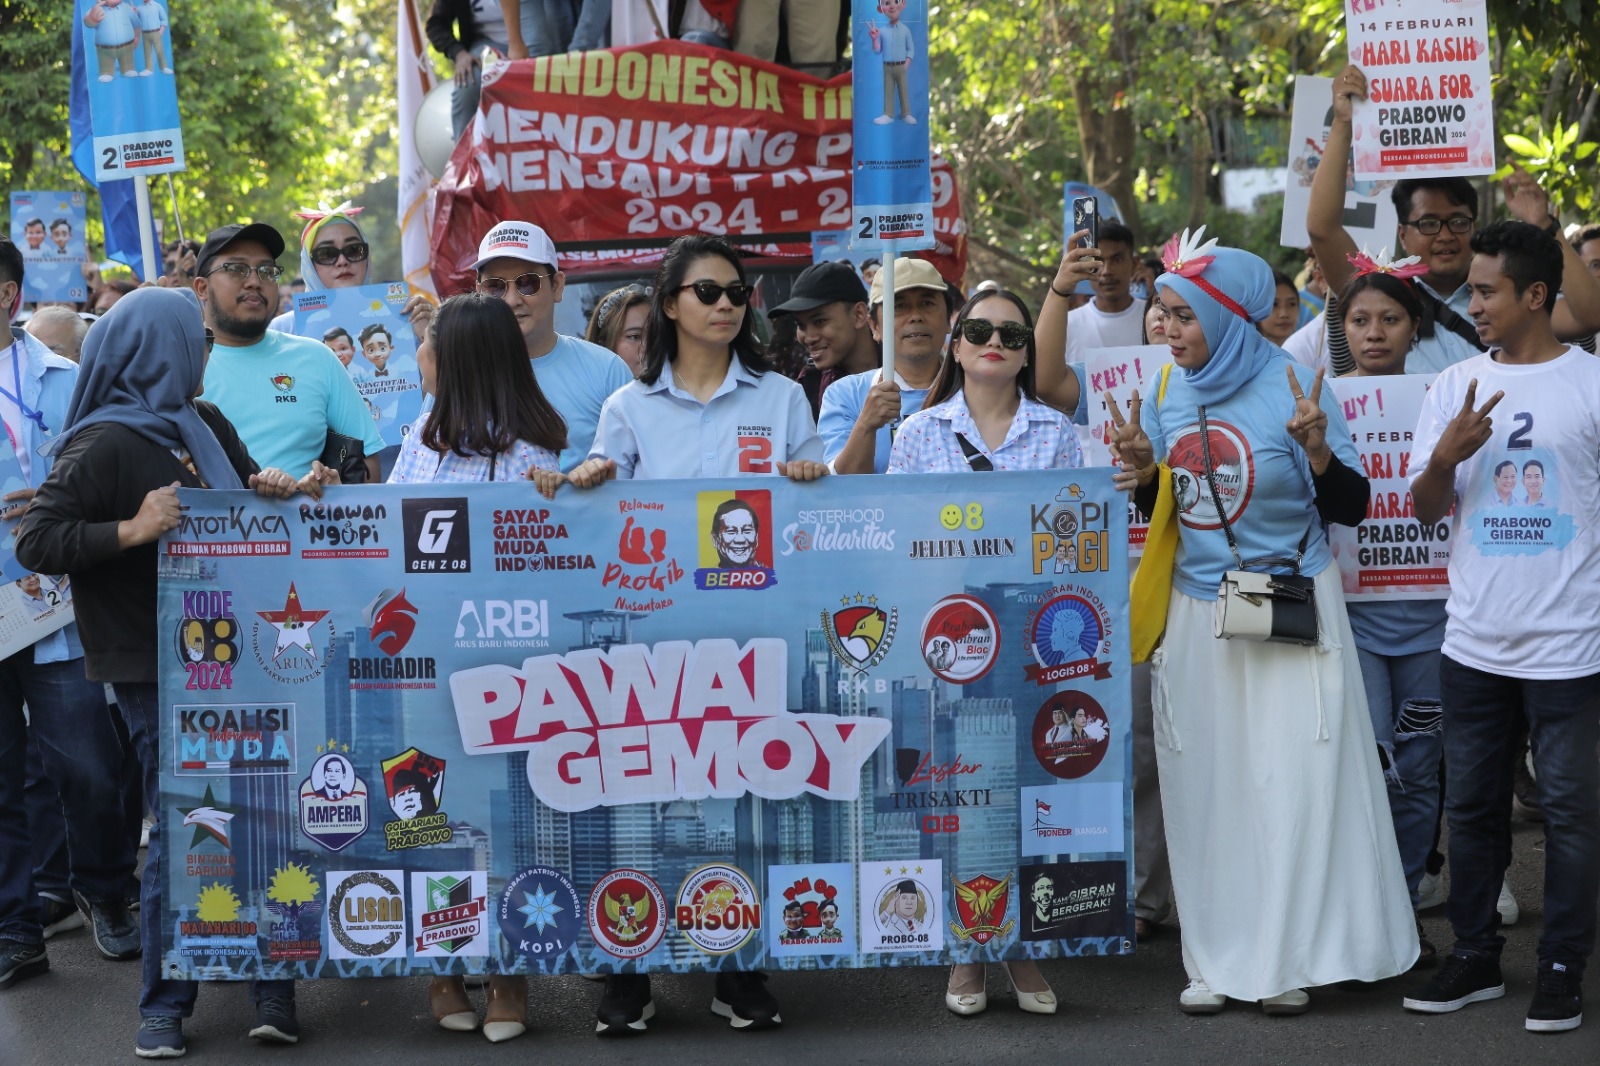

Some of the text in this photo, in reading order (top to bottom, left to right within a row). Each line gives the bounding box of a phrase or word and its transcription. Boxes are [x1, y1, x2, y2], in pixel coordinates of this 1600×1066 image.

[1360, 17, 1474, 32] 14 FEBRUARI
[1363, 36, 1477, 67] HARI KASIH
[533, 50, 784, 114] INDONESIA
[1370, 73, 1474, 103] SUARA FOR
[1378, 104, 1466, 125] PRABOWO
[473, 102, 798, 169] MENDUKUNG
[1380, 127, 1447, 147] GIBRAN
[123, 140, 172, 152] PRABOWO
[124, 150, 162, 160] GIBRAN
[102, 147, 118, 170] 2
[624, 196, 763, 237] 2024
[878, 213, 924, 223] PRABOWO
[488, 228, 529, 240] PRABOWO
[858, 216, 874, 239] 2
[879, 222, 914, 232] GIBRAN
[488, 235, 519, 246] GIBRAN
[1091, 362, 1128, 394] KUY
[275, 395, 297, 404] RKB
[1343, 393, 1369, 421] UY
[1366, 431, 1413, 443] FEBR
[1507, 411, 1534, 451] 2
[737, 437, 772, 473] 2
[1360, 452, 1393, 480] ARI
[299, 502, 387, 523] Relawan
[619, 498, 664, 513] Relawan
[493, 509, 550, 524] SAYAP
[798, 508, 884, 524] SISTERHOOD
[1030, 501, 1109, 540] KOPI
[1483, 517, 1552, 528] PRABOWO
[493, 524, 569, 539] GARUDA
[780, 521, 896, 556] Solidaritas
[1357, 523, 1450, 544] PRABOWO
[1490, 529, 1544, 540] GIBRAN
[171, 543, 287, 555] RELAWAN PRABOWO GIBRAN
[494, 540, 549, 555] MUDA
[909, 537, 1017, 559] JELITA ARUN
[1032, 530, 1109, 575] PAGI
[1358, 546, 1429, 566] GIBRAN
[412, 559, 467, 570] GEN Z 08
[495, 555, 596, 572] INDONESIA
[705, 571, 767, 587] BEPRO
[47, 590, 61, 606] 2
[183, 590, 235, 619] KODE
[454, 599, 550, 638] ARBI
[1076, 585, 1112, 637] INDONESIA
[454, 639, 549, 648] ARUS BARU INDONESIA
[966, 645, 988, 654] Bloc
[273, 657, 315, 671] ARUN
[349, 657, 436, 679] BRIGADIR
[1047, 663, 1089, 681] LOGIS 08
[185, 661, 234, 690] 2024
[450, 639, 787, 754] PAWAI
[180, 708, 289, 733] KOALISI
[181, 735, 291, 761] MUDA
[528, 717, 891, 811] GEMOY
[906, 751, 982, 787] Laskar
[889, 789, 992, 809] TRISAKTI
[307, 805, 362, 823] AMPERA
[385, 814, 446, 833] GOLKARIANS
[922, 814, 960, 834] 08
[1074, 826, 1108, 835] BANGSA
[387, 828, 451, 850] PRABOWO
[1038, 828, 1072, 838] PIONEER
[186, 854, 236, 865] BINTANG
[186, 866, 236, 876] GARUDA
[614, 871, 634, 879] PUSAT
[501, 868, 581, 920] KOLABORASI PATRIOT INDONESIA
[1069, 882, 1116, 899] GIBRAN
[344, 897, 404, 922] LISAN
[429, 907, 470, 923] SETIA
[1052, 897, 1111, 917] BERGERAK!
[676, 904, 761, 931] BISON
[181, 921, 240, 935] MATAHARI
[425, 924, 476, 942] PRABOWO
[519, 939, 563, 954] KOPI
[820, 937, 843, 945] MUDA
[881, 933, 929, 944] PROBO-08
[181, 948, 256, 957] UNTUK INDONESIA MAJU
[609, 945, 624, 954] DPP
